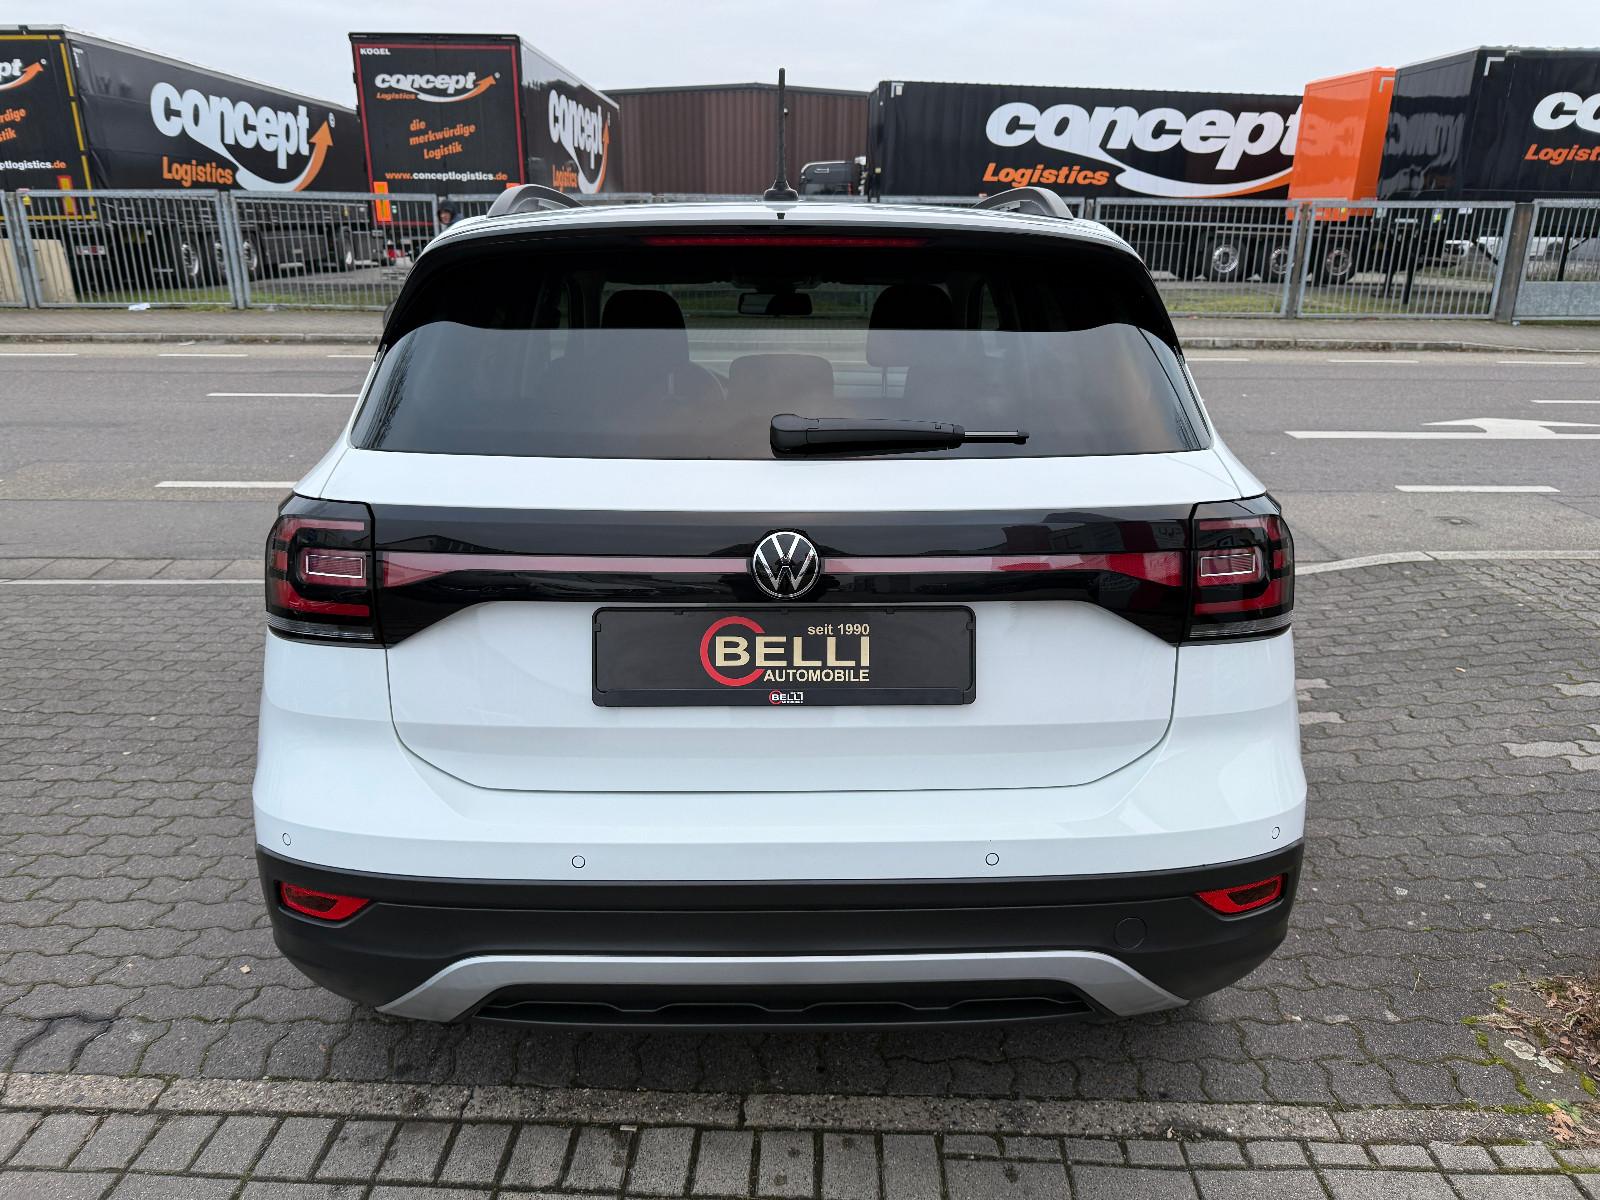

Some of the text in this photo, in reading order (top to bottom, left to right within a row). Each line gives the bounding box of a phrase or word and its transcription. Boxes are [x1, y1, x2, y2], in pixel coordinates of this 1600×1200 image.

[375, 71, 476, 94] concept
[376, 92, 417, 101] Logistics
[151, 81, 309, 170] concept
[409, 123, 476, 145] merkwürdige
[410, 118, 426, 131] die
[549, 89, 603, 170] concept
[986, 102, 1303, 171] concept
[423, 141, 463, 159] Logistik
[162, 155, 233, 188] Logistics
[385, 170, 508, 182] www.conceptlogistics.de
[983, 162, 1110, 187] Logistics
[807, 623, 869, 635] seit 1990
[715, 636, 869, 667] BELLI
[763, 669, 869, 682] AUTOMOBILE
